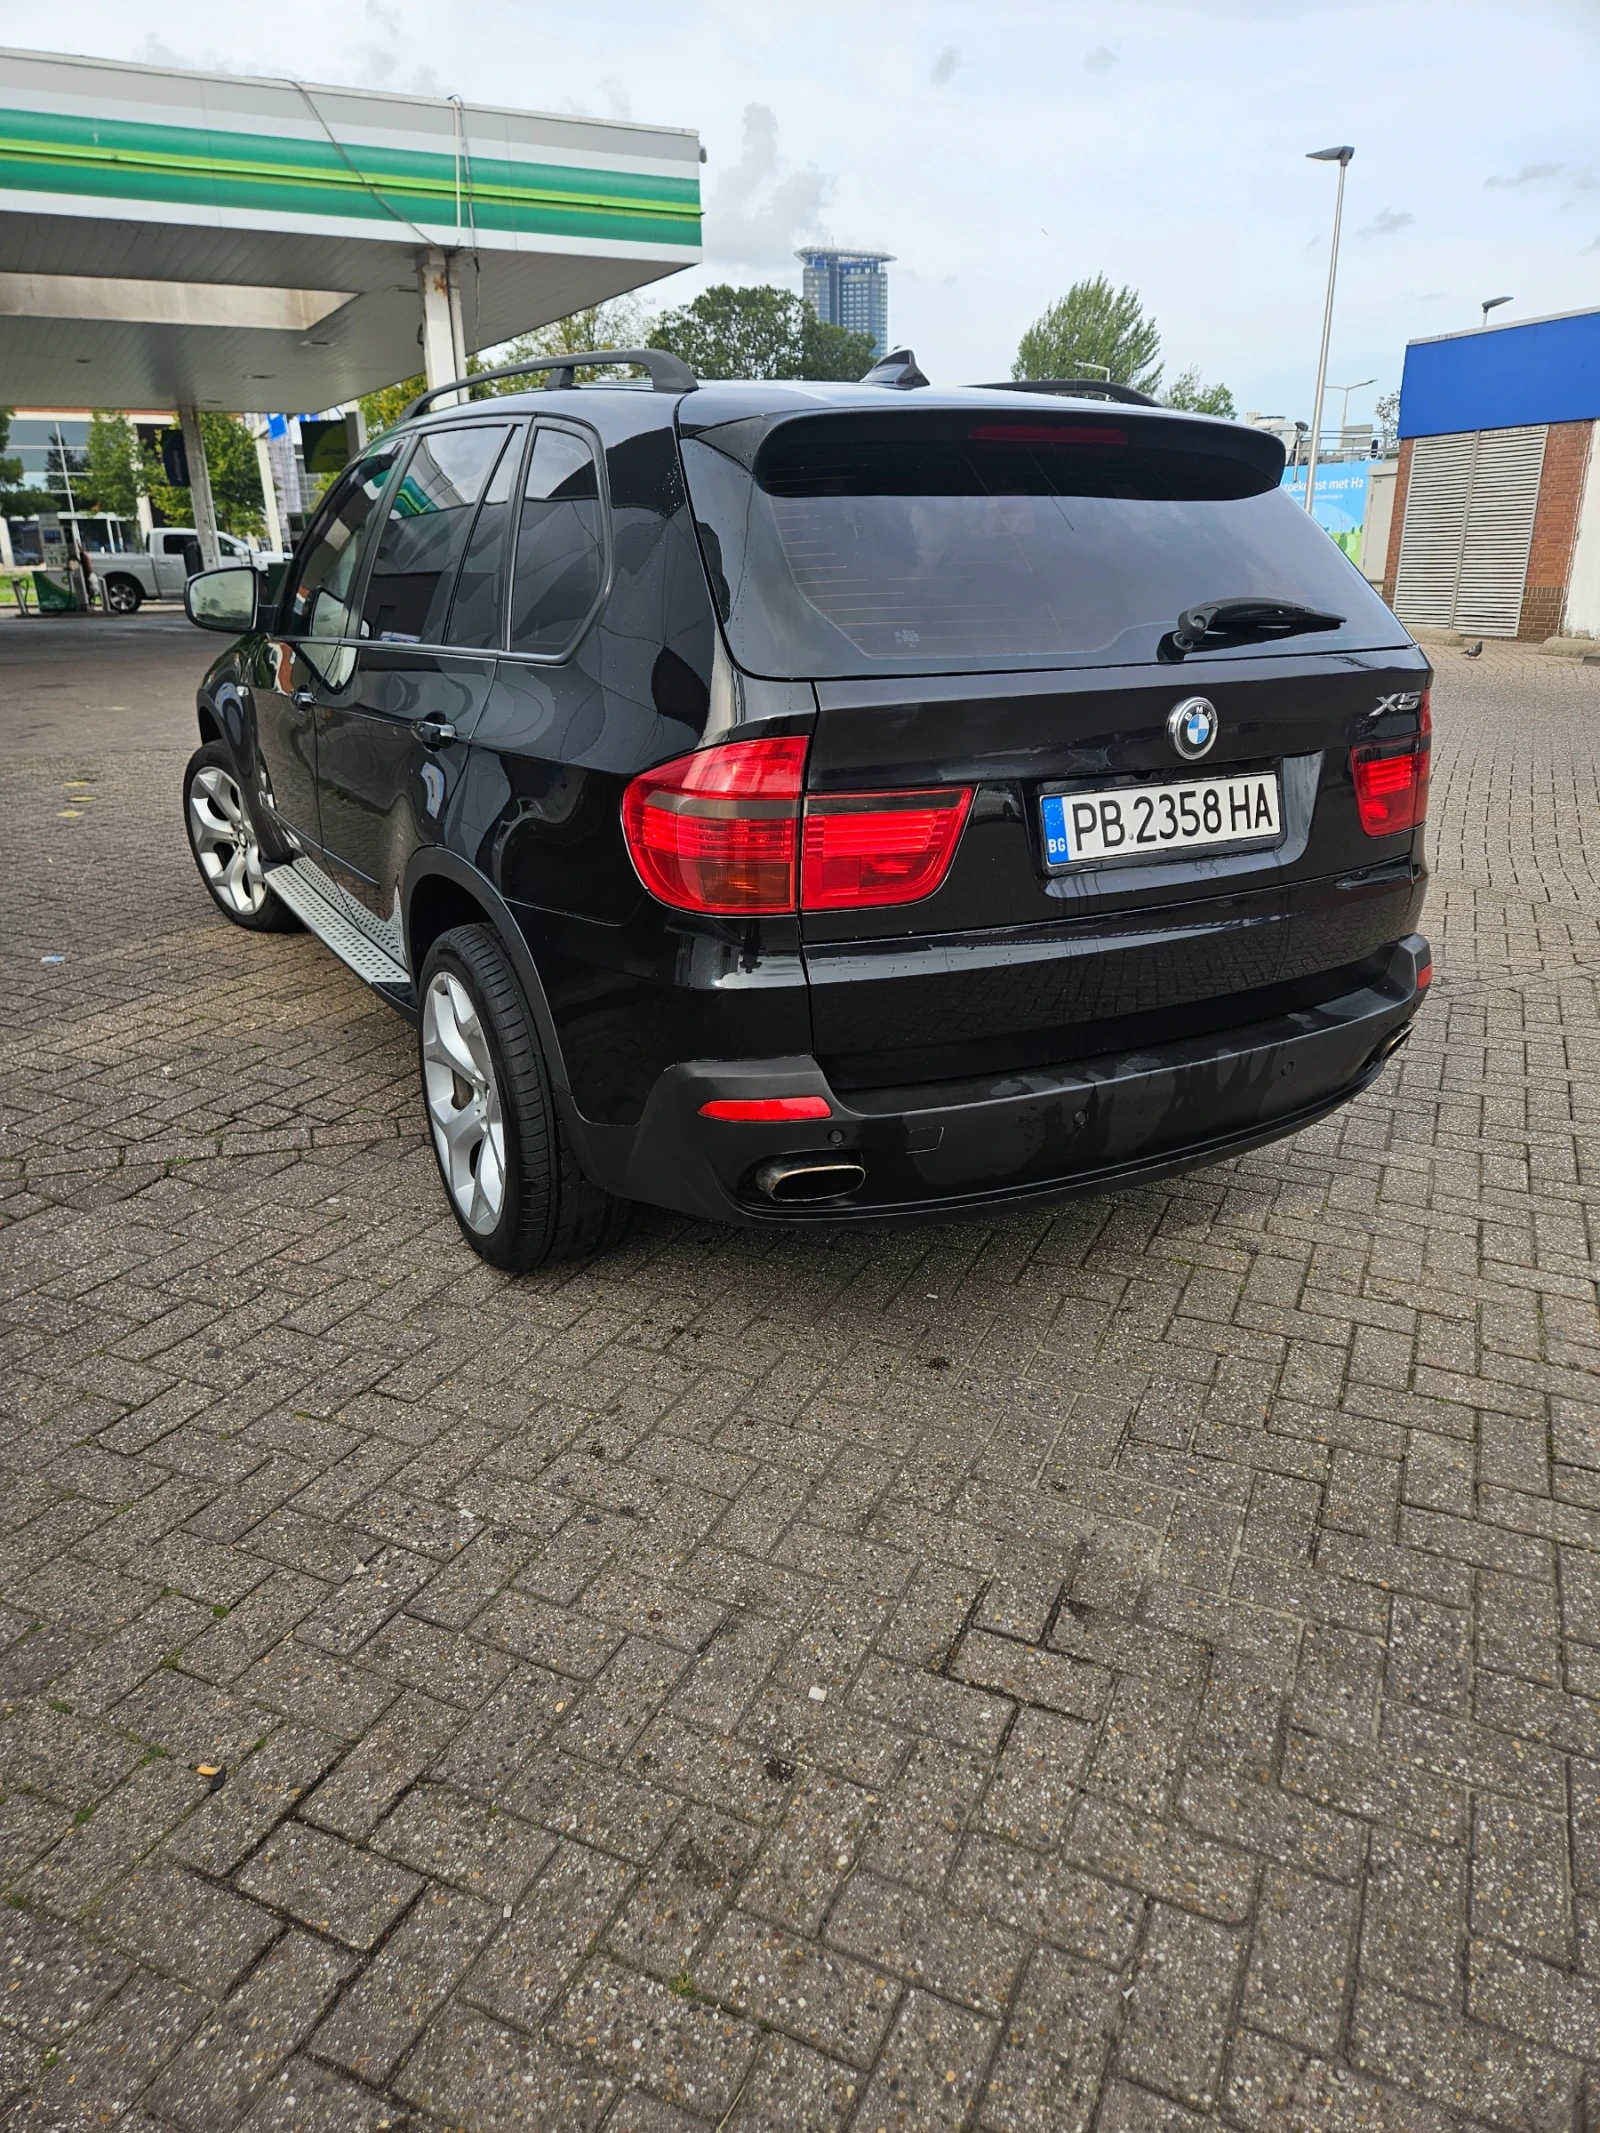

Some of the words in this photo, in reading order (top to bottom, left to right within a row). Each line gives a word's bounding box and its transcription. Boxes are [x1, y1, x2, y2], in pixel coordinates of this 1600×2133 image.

[1329, 478, 1349, 490] met
[1351, 476, 1364, 489] H2
[1369, 691, 1421, 717] X5
[1184, 706, 1213, 721] BMW
[1072, 800, 1125, 851] PB
[1133, 788, 1222, 844] 2358
[1229, 783, 1273, 832] HA
[1048, 838, 1067, 853] BG
